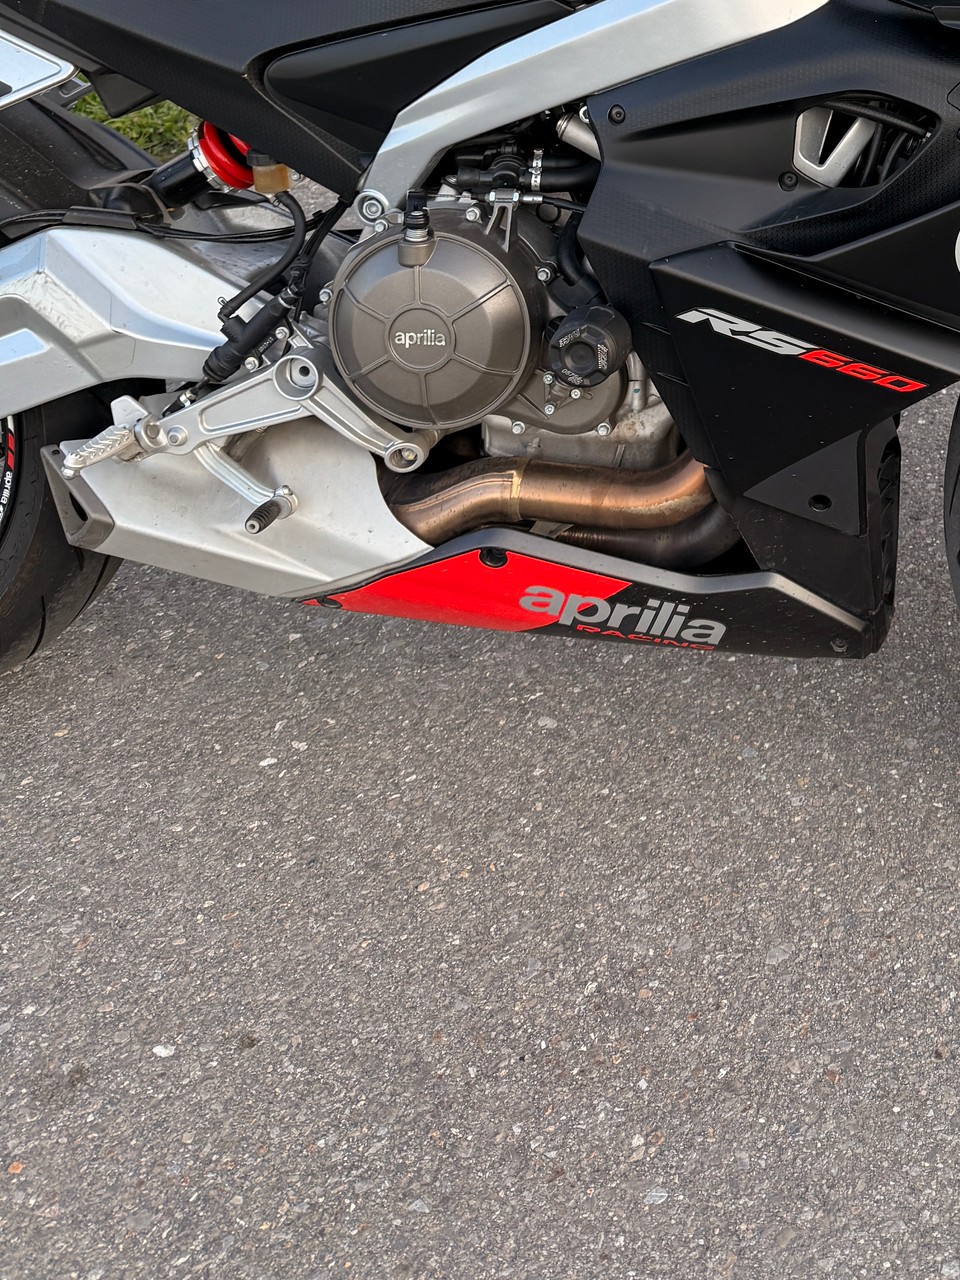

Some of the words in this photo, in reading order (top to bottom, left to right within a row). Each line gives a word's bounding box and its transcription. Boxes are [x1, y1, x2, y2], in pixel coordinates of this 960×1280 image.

[394, 329, 446, 349] aprilia
[675, 307, 929, 392] RS660
[1, 471, 13, 504] aprilia
[519, 585, 727, 645] aprilia
[576, 624, 715, 651] RACING
